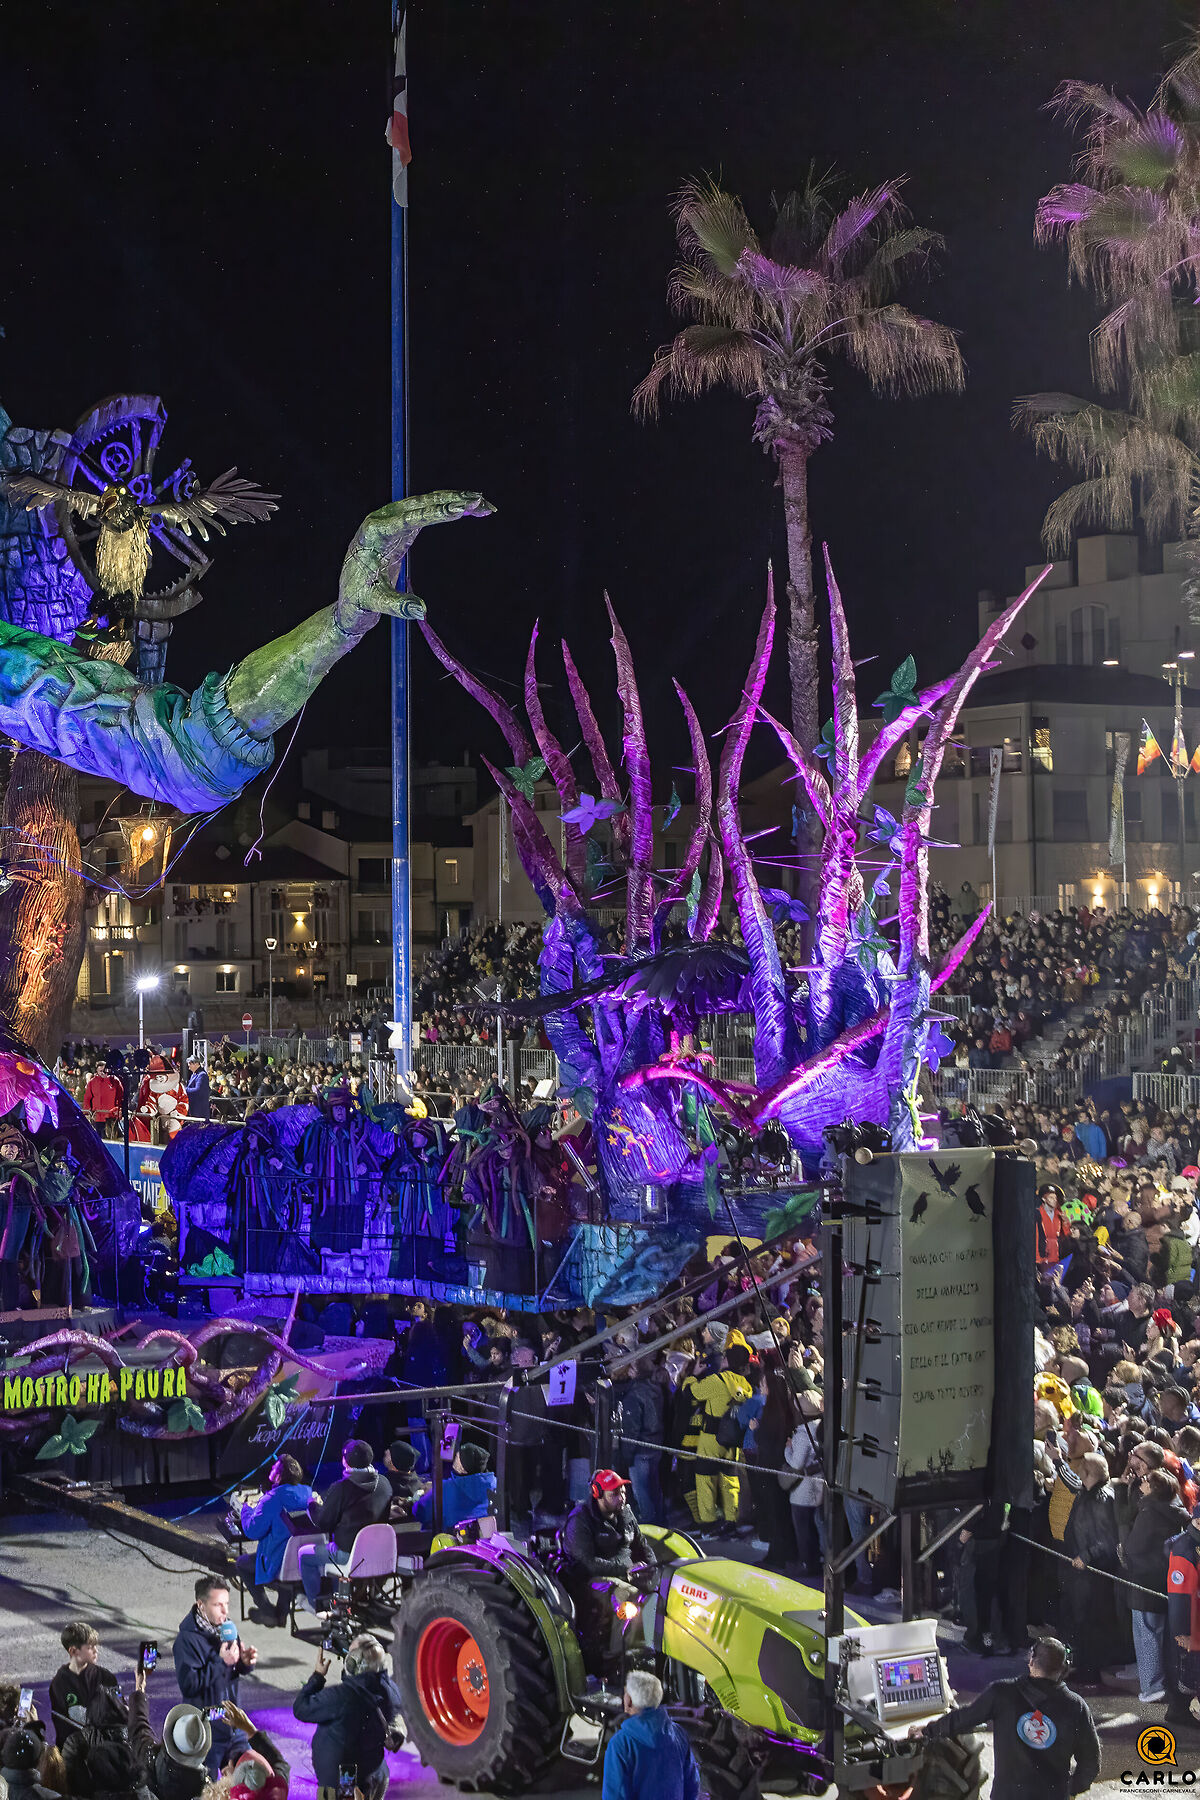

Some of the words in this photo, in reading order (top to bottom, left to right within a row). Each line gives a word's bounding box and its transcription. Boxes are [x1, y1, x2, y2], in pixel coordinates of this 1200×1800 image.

[4, 1375, 81, 1409] MOSTRO
[87, 1373, 110, 1403] HA
[120, 1366, 187, 1402] PAURA
[681, 1584, 709, 1600] CLAAS
